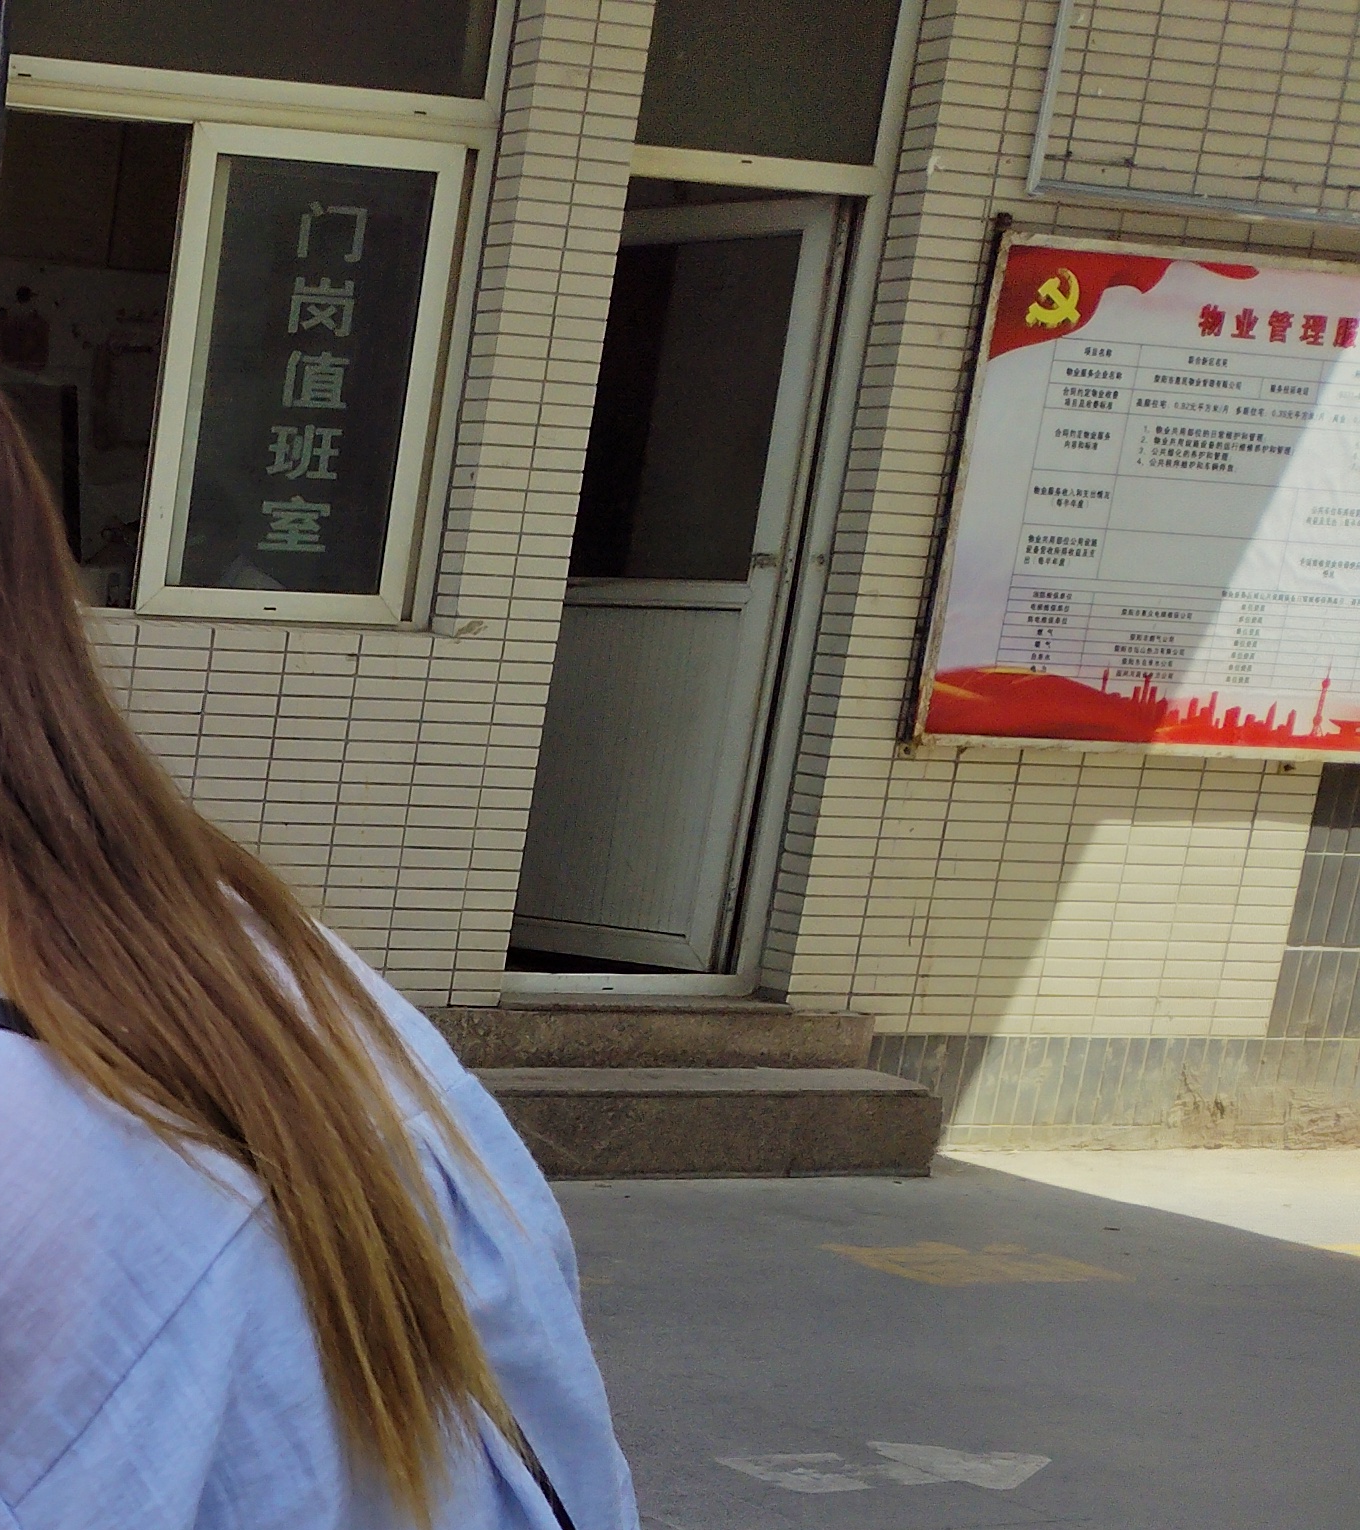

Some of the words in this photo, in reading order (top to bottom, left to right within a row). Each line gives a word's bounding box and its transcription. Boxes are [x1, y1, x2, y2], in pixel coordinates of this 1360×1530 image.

[257, 201, 368, 553] 门岗值班室
